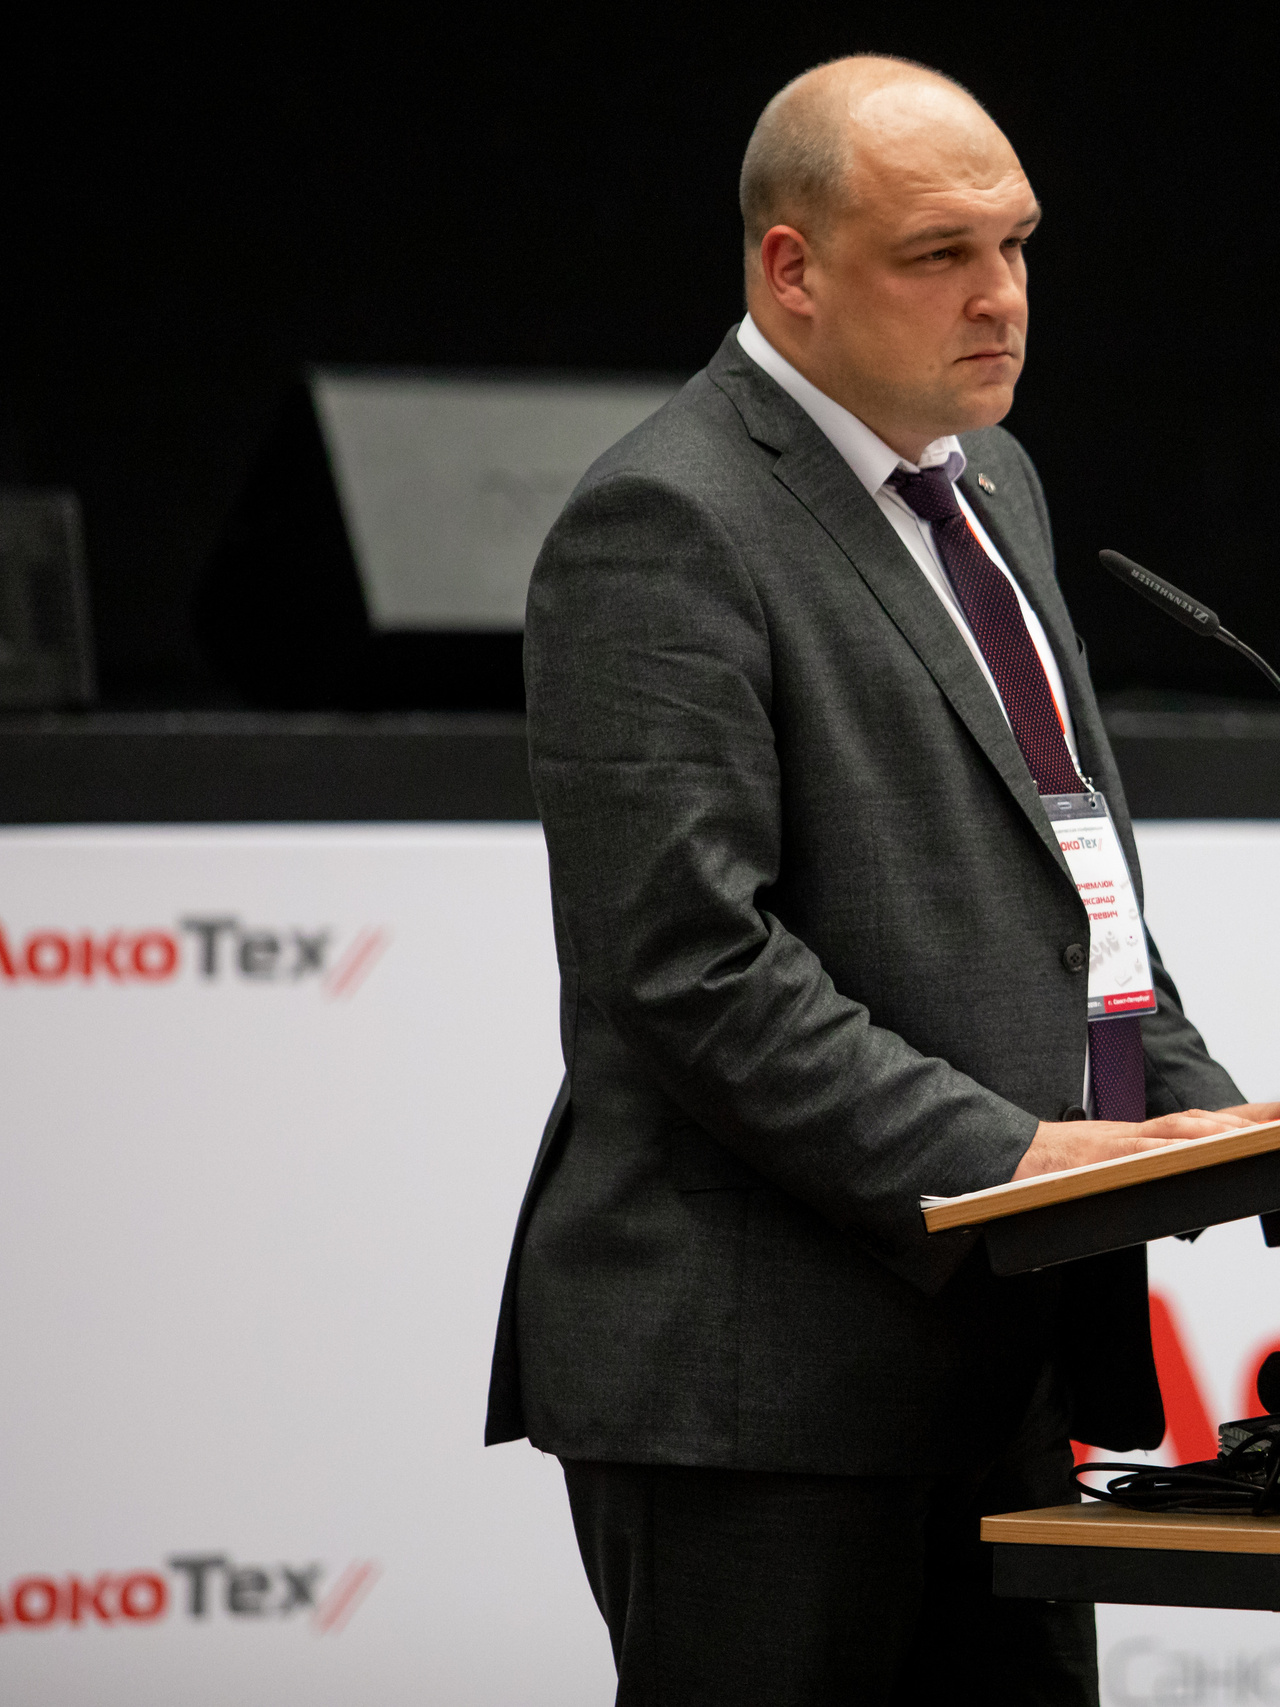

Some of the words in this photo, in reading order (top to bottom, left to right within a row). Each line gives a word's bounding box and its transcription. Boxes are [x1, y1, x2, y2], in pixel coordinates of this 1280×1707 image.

[1131, 568, 1194, 613] SENNHEISER
[1060, 837, 1097, 851] окоТех
[0, 1552, 322, 1632] окоТех
